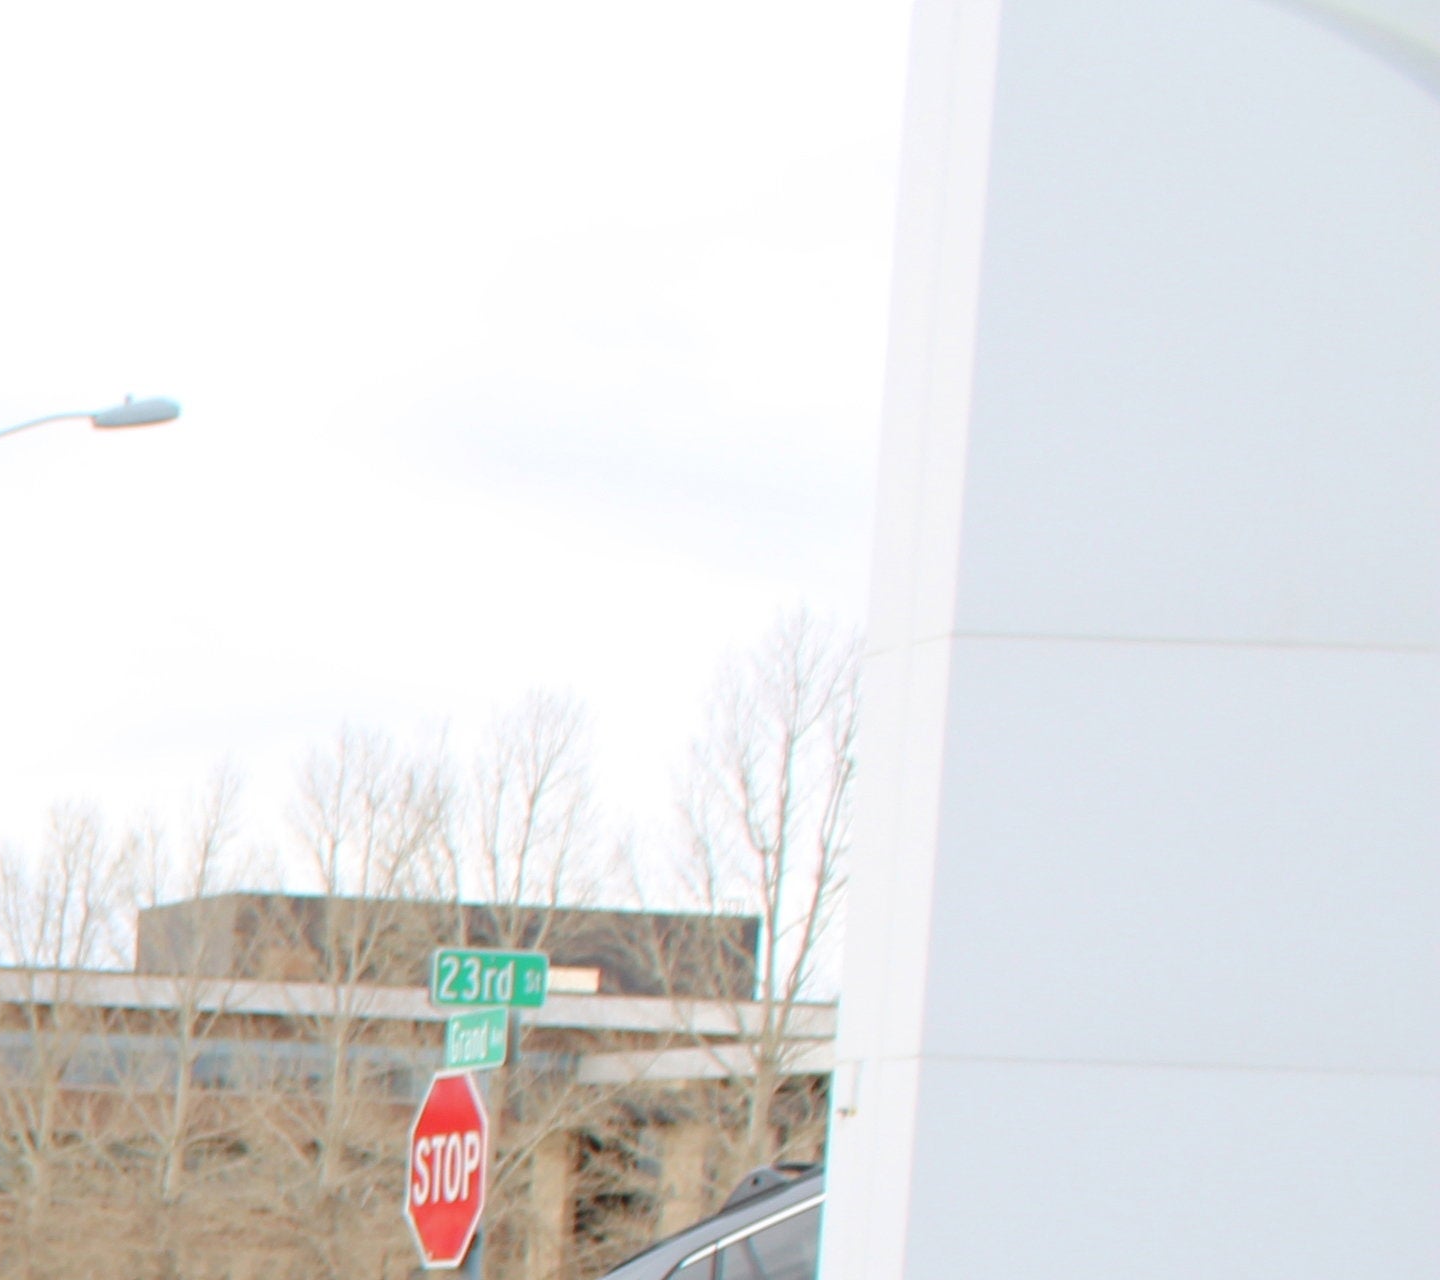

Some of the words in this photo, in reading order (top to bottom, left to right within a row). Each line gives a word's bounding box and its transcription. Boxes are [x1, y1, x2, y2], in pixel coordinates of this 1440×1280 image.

[439, 956, 515, 1001] 23rd
[450, 1020, 490, 1064] Grand
[412, 1130, 480, 1208] STOP
